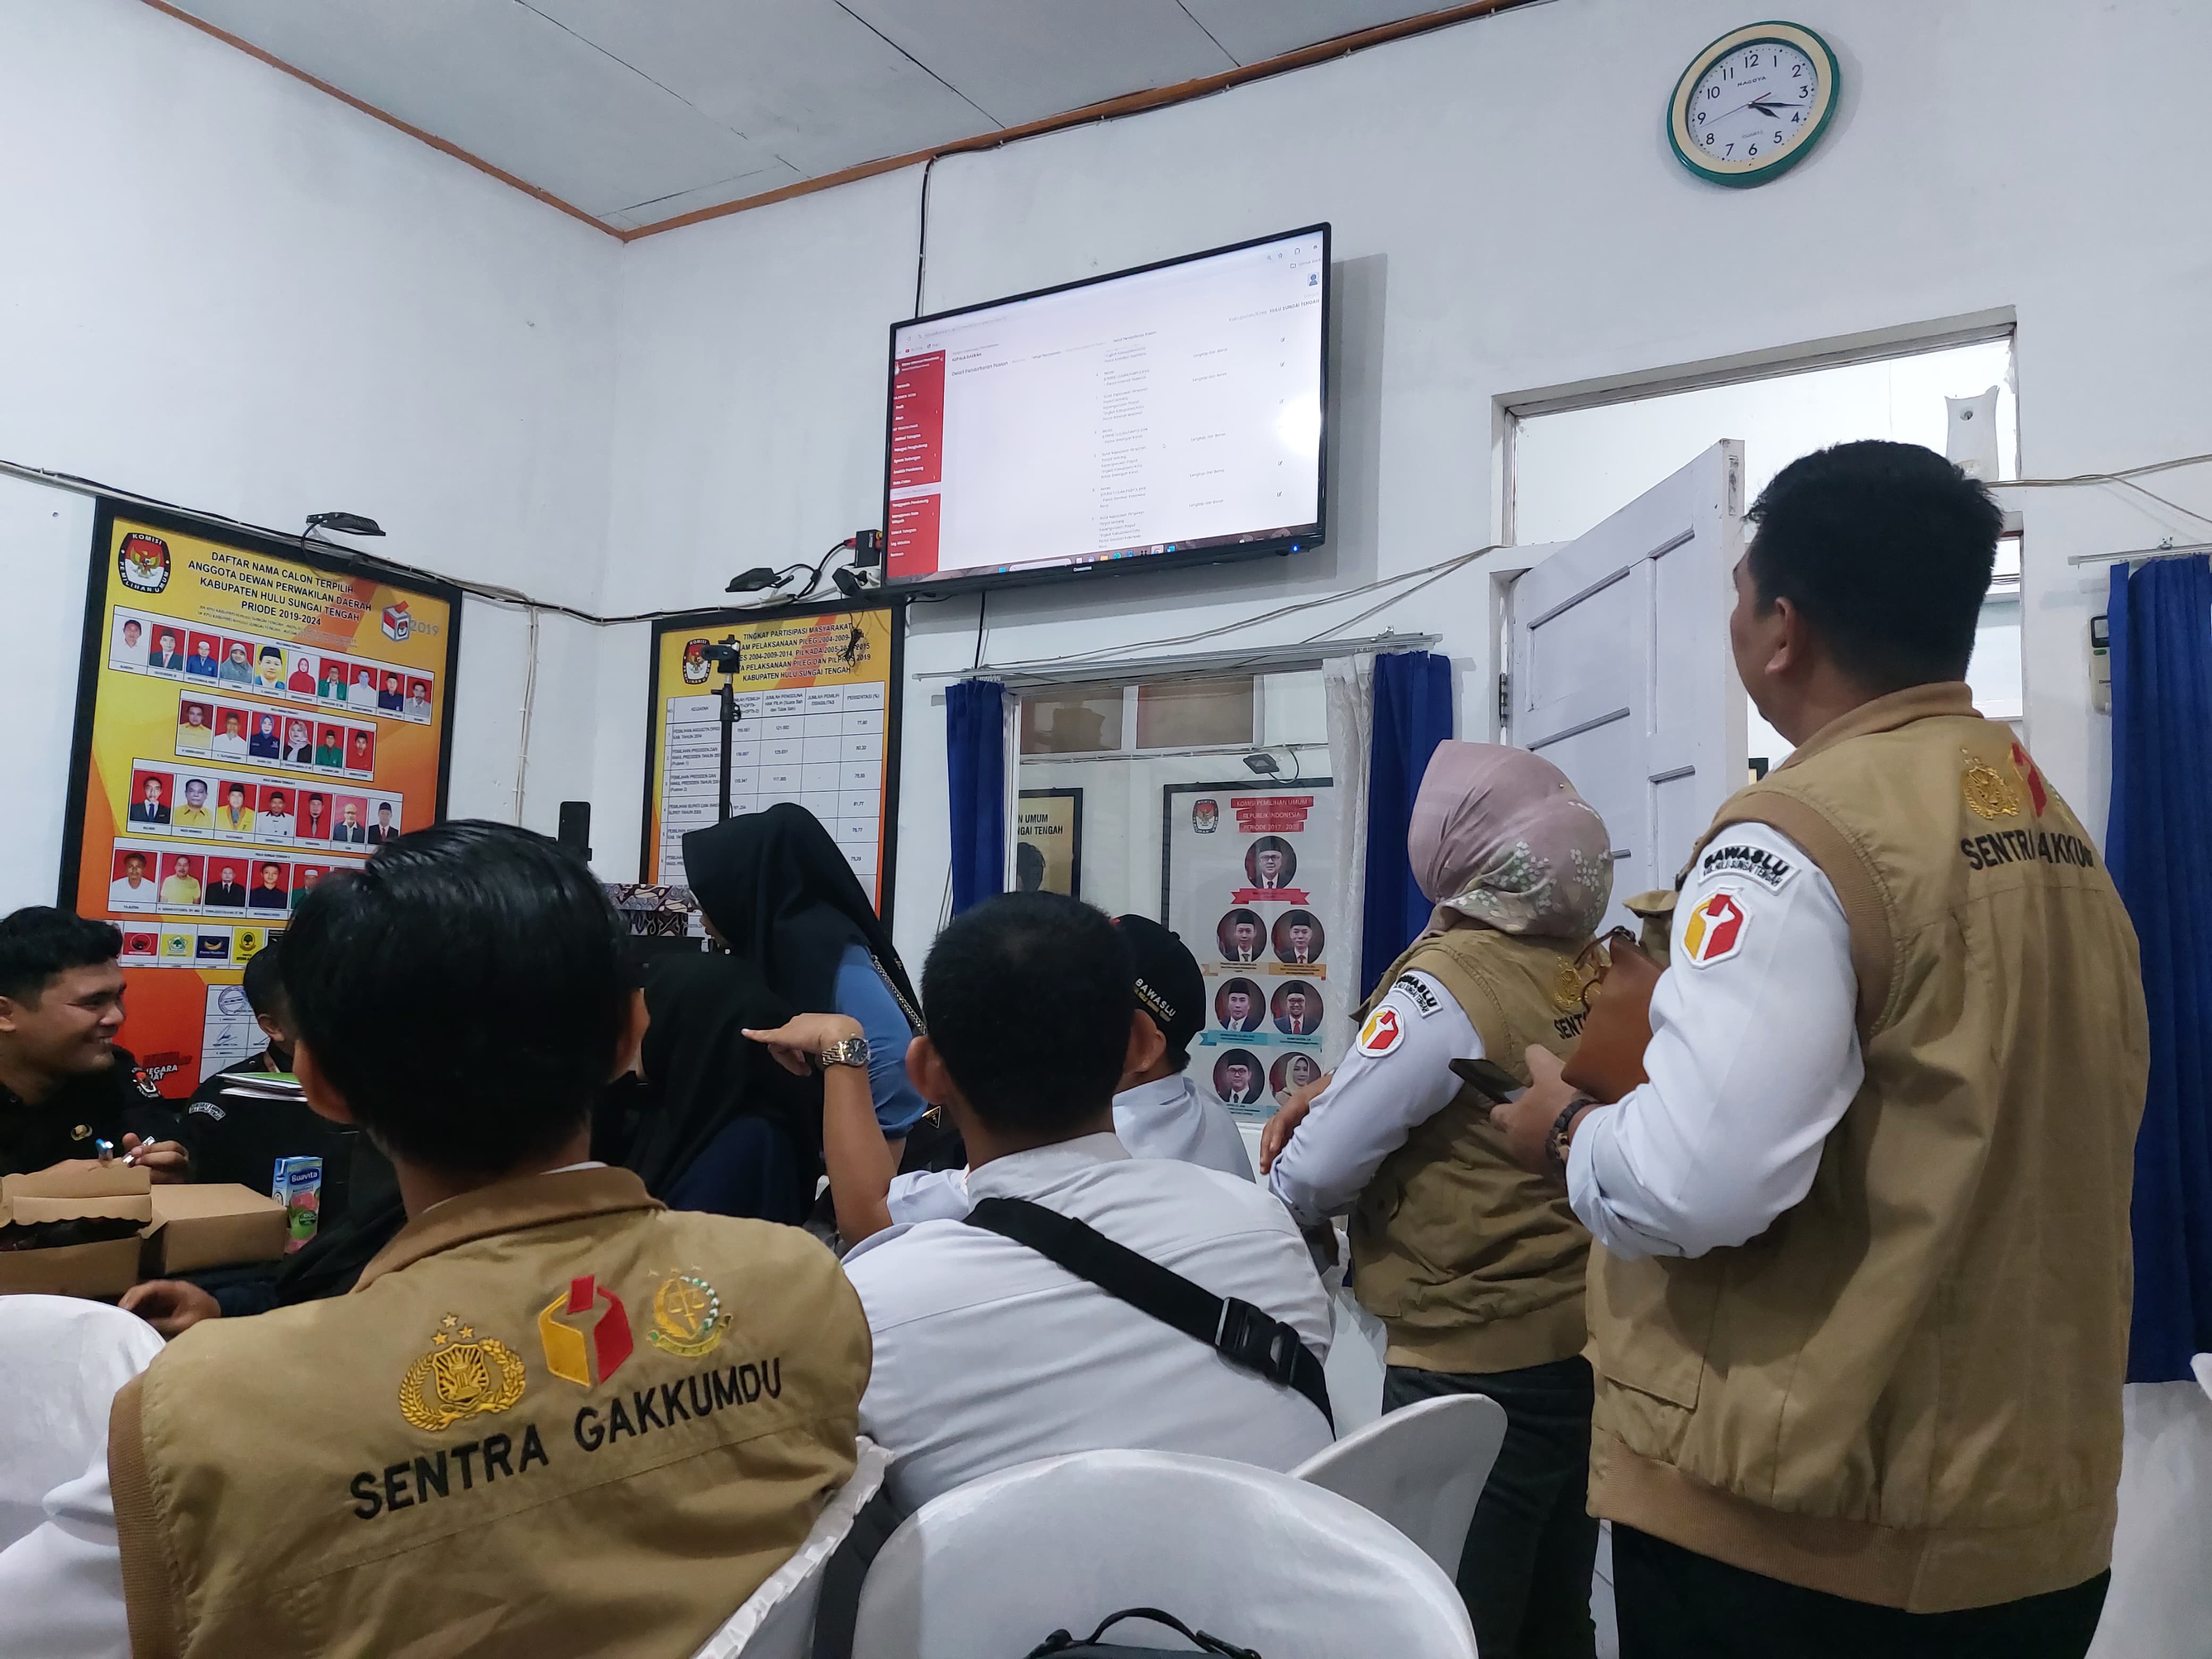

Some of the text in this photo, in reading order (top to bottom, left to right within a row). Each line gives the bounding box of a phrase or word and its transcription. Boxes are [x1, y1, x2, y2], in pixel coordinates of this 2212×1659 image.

[1745, 54, 1759, 69] 12
[1774, 55, 1777, 67] 1
[1723, 67, 1733, 81] 11
[1792, 64, 1802, 78] 2
[1738, 76, 1766, 87] NAGOYA
[1707, 86, 1720, 99] 10
[1799, 85, 1808, 98] 3
[1697, 112, 1706, 125] 9
[1791, 111, 1800, 123] 4
[1706, 133, 1714, 145] 8
[1773, 131, 1782, 144] 5
[1725, 143, 1735, 156] 7
[1748, 143, 1757, 156] 6
[132, 534, 162, 545] KOMISI
[119, 561, 152, 592] PEMILIHAN
[212, 552, 353, 593] DAFTAR NAMA CALON TERPILIH
[155, 571, 169, 592] UMUM
[188, 560, 372, 611] ANGGOTA DEWAN PERWAKILAN DAERAH
[200, 577, 359, 622] KABUPATEN HULU SUNGAI TENGAH
[241, 601, 321, 625] PRIODE 2019-2024
[410, 619, 439, 636] 2019
[743, 623, 851, 640] TINGKAT PARTISIPASI MASYARAKAT
[752, 639, 797, 649] PELAKSANAAN
[746, 661, 791, 671] PELAKSANAAN
[743, 673, 779, 682] KABUPATEN
[1025, 814, 1048, 823] UMUM
[1034, 825, 1063, 835] TENGAH
[1135, 978, 1177, 1017] BAWASLU
[291, 1171, 318, 1183] Buavita
[350, 1357, 782, 1520] SENTRA GAKKUMDU
